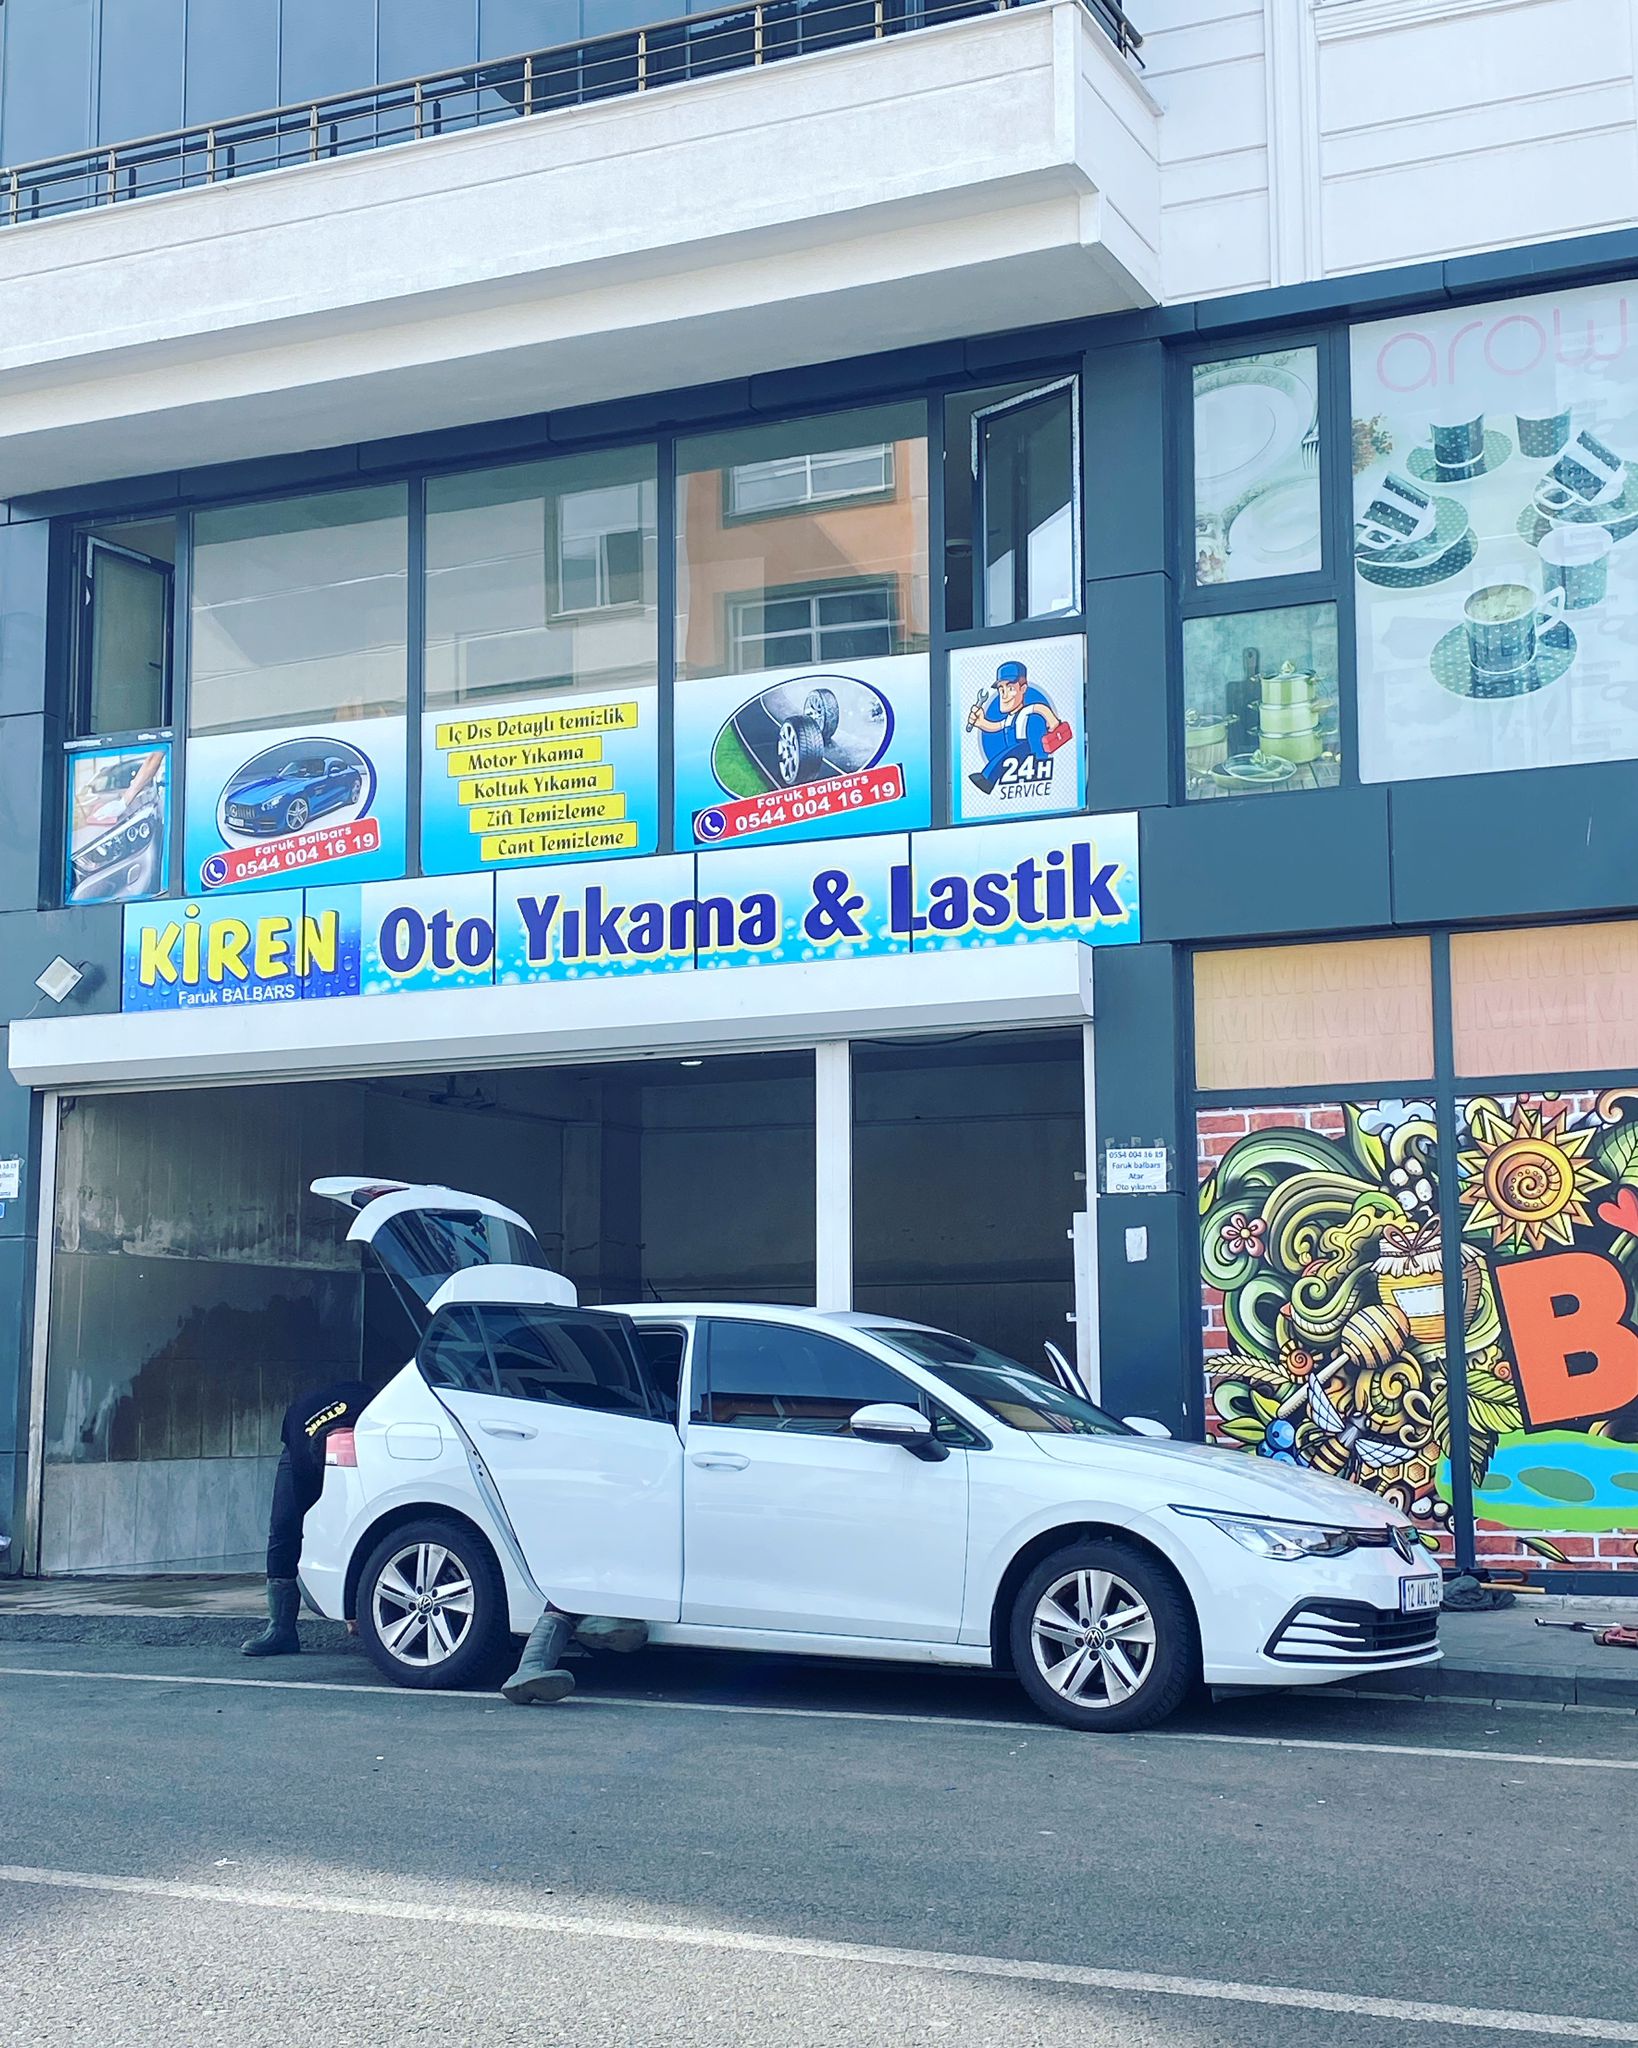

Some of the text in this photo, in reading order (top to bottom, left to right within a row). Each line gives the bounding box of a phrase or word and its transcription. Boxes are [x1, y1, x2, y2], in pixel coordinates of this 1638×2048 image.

[497, 715, 554, 737] Detaylı
[559, 708, 624, 730] temizlik
[468, 747, 583, 770] Motor Yıkama
[474, 775, 597, 799] Koltuk Yıkama
[757, 775, 869, 809] Faruk Balbars
[1000, 782, 1052, 800] SERVICE
[487, 803, 606, 827] Zift Temizleme
[735, 781, 895, 831] 0544 004 16 19
[235, 832, 375, 877] 0544 004 16 19
[255, 825, 352, 857] Faruk Balbars
[498, 831, 624, 855] Cant Temizleme
[379, 842, 1123, 973] Oto Yıkama & Lastik
[138, 903, 340, 988] KİREN
[178, 984, 296, 1005] Faruk BALBARS
